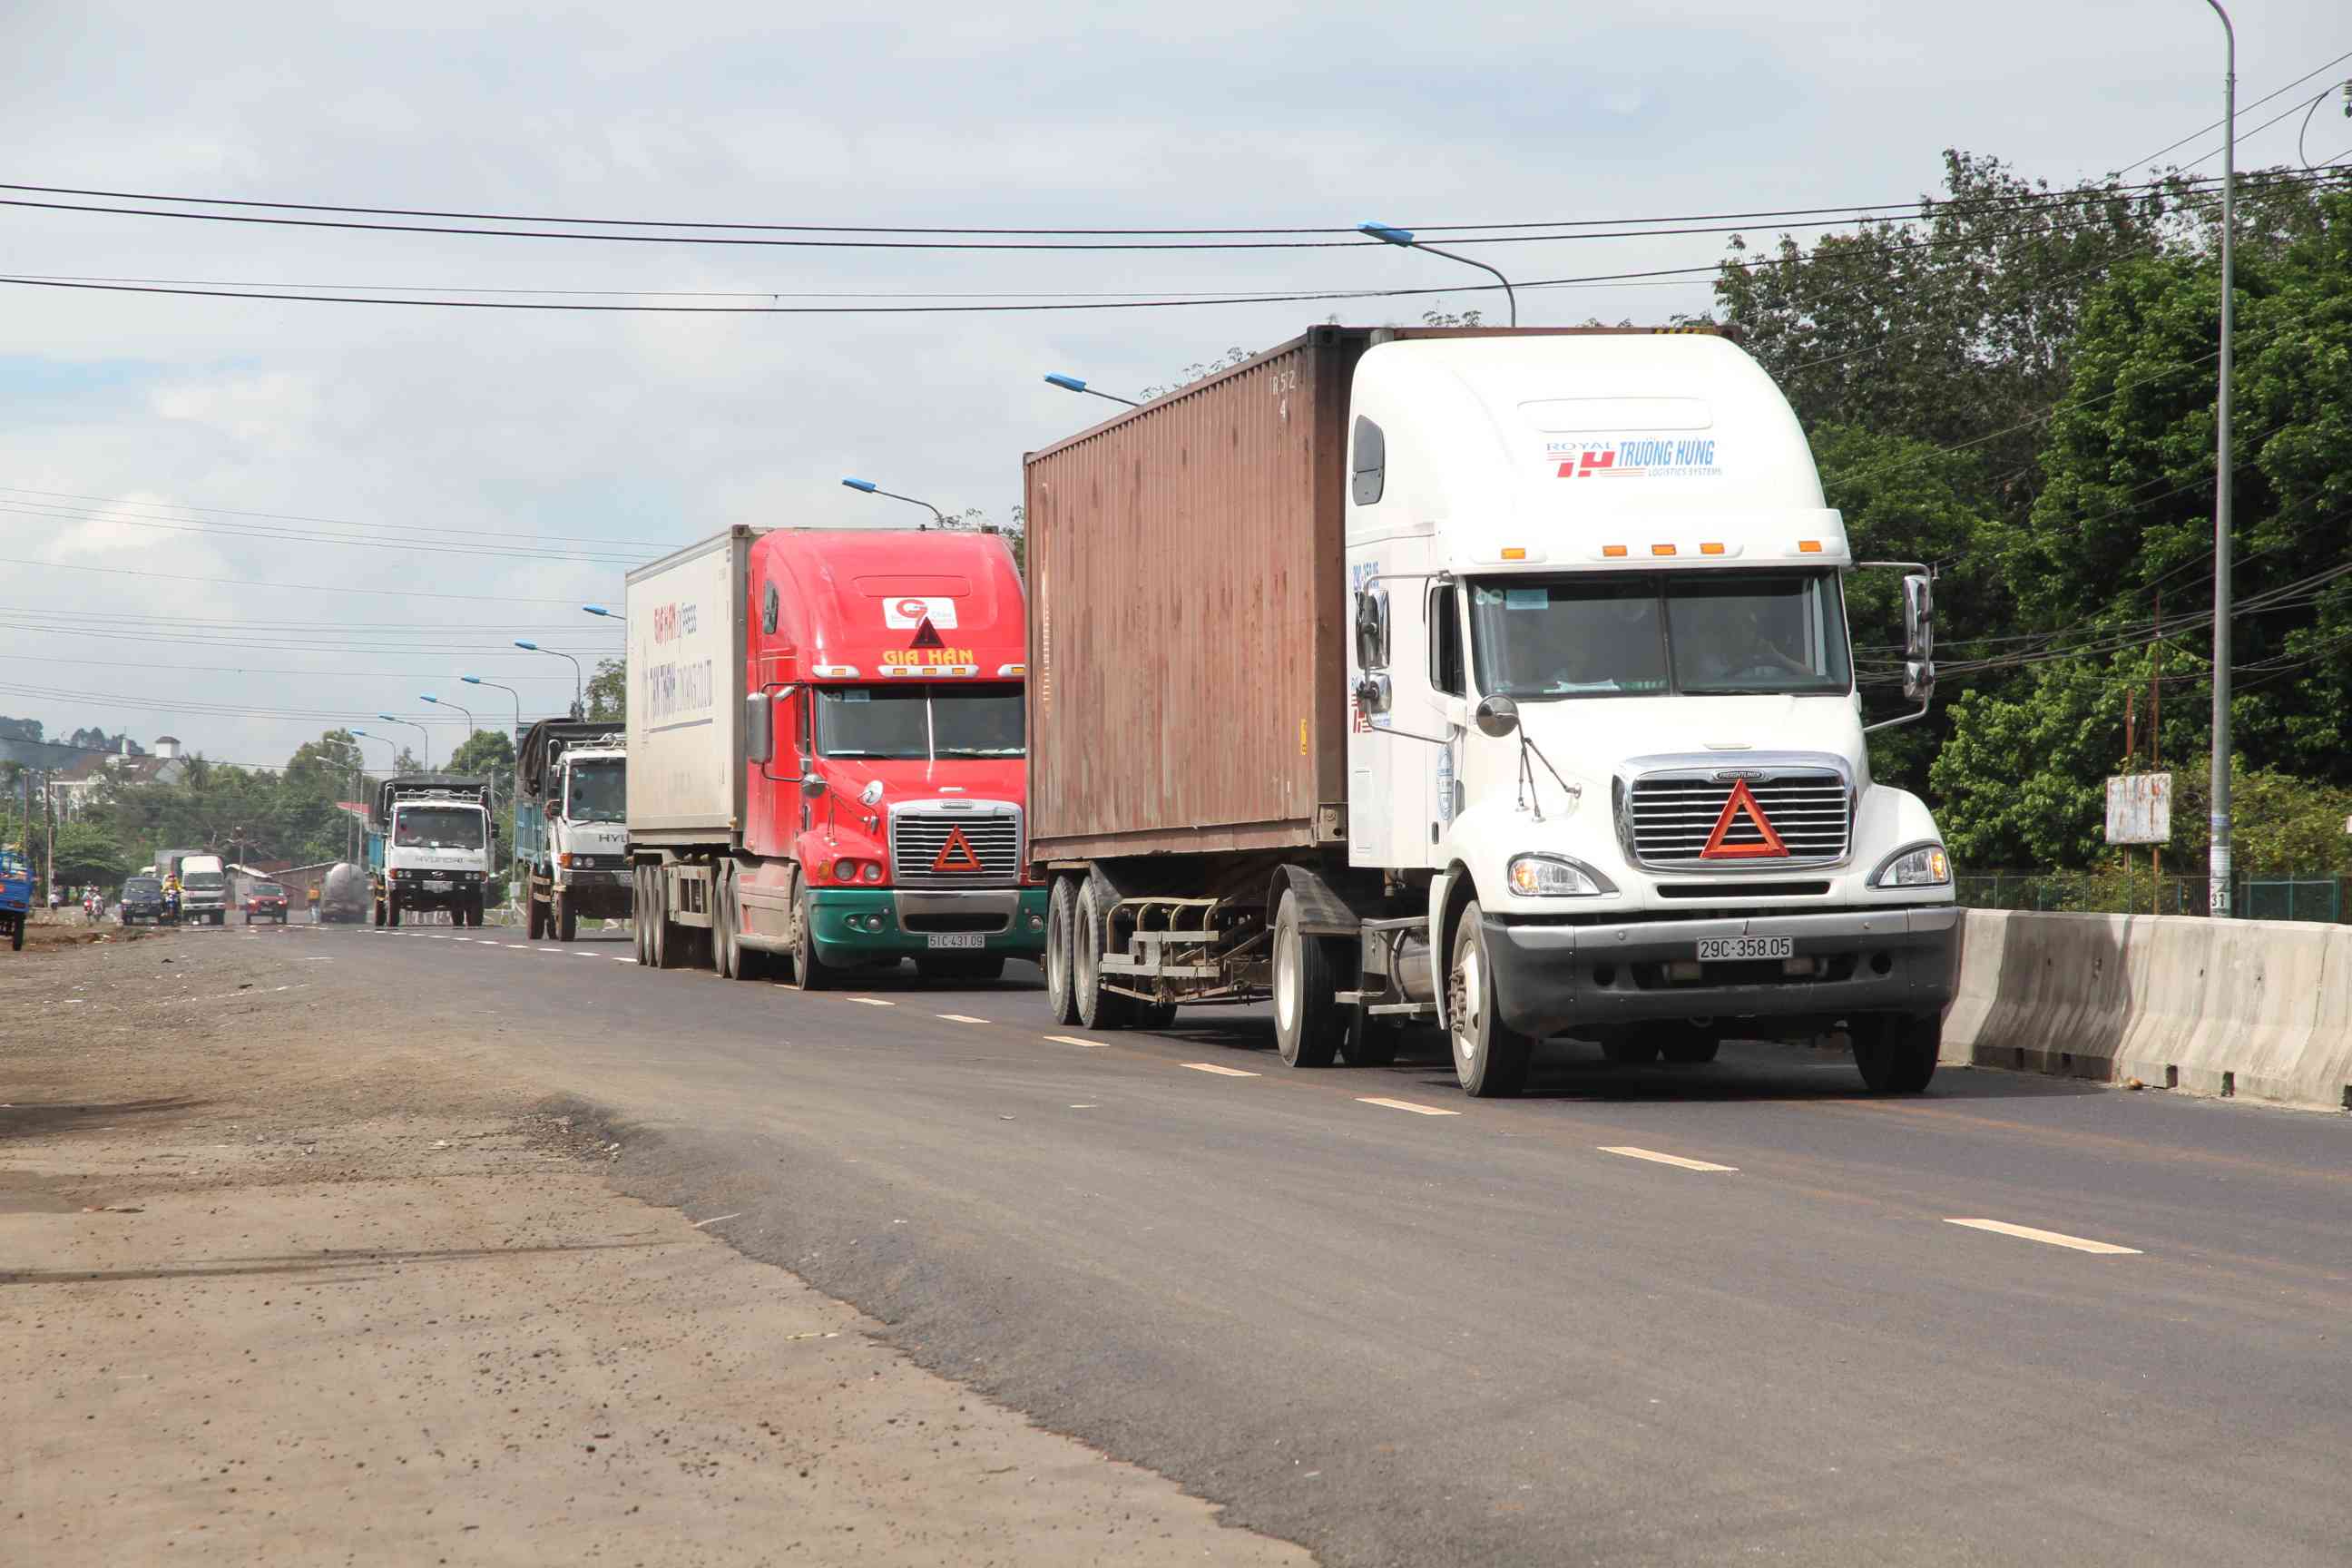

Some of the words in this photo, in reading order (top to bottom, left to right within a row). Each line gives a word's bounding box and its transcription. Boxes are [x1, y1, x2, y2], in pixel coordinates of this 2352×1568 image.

[1546, 442, 1612, 451] ROYAL
[1648, 467, 1686, 477] LOGISTICS
[883, 650, 918, 665] GIA
[1700, 937, 1790, 959] 29C-358.05
